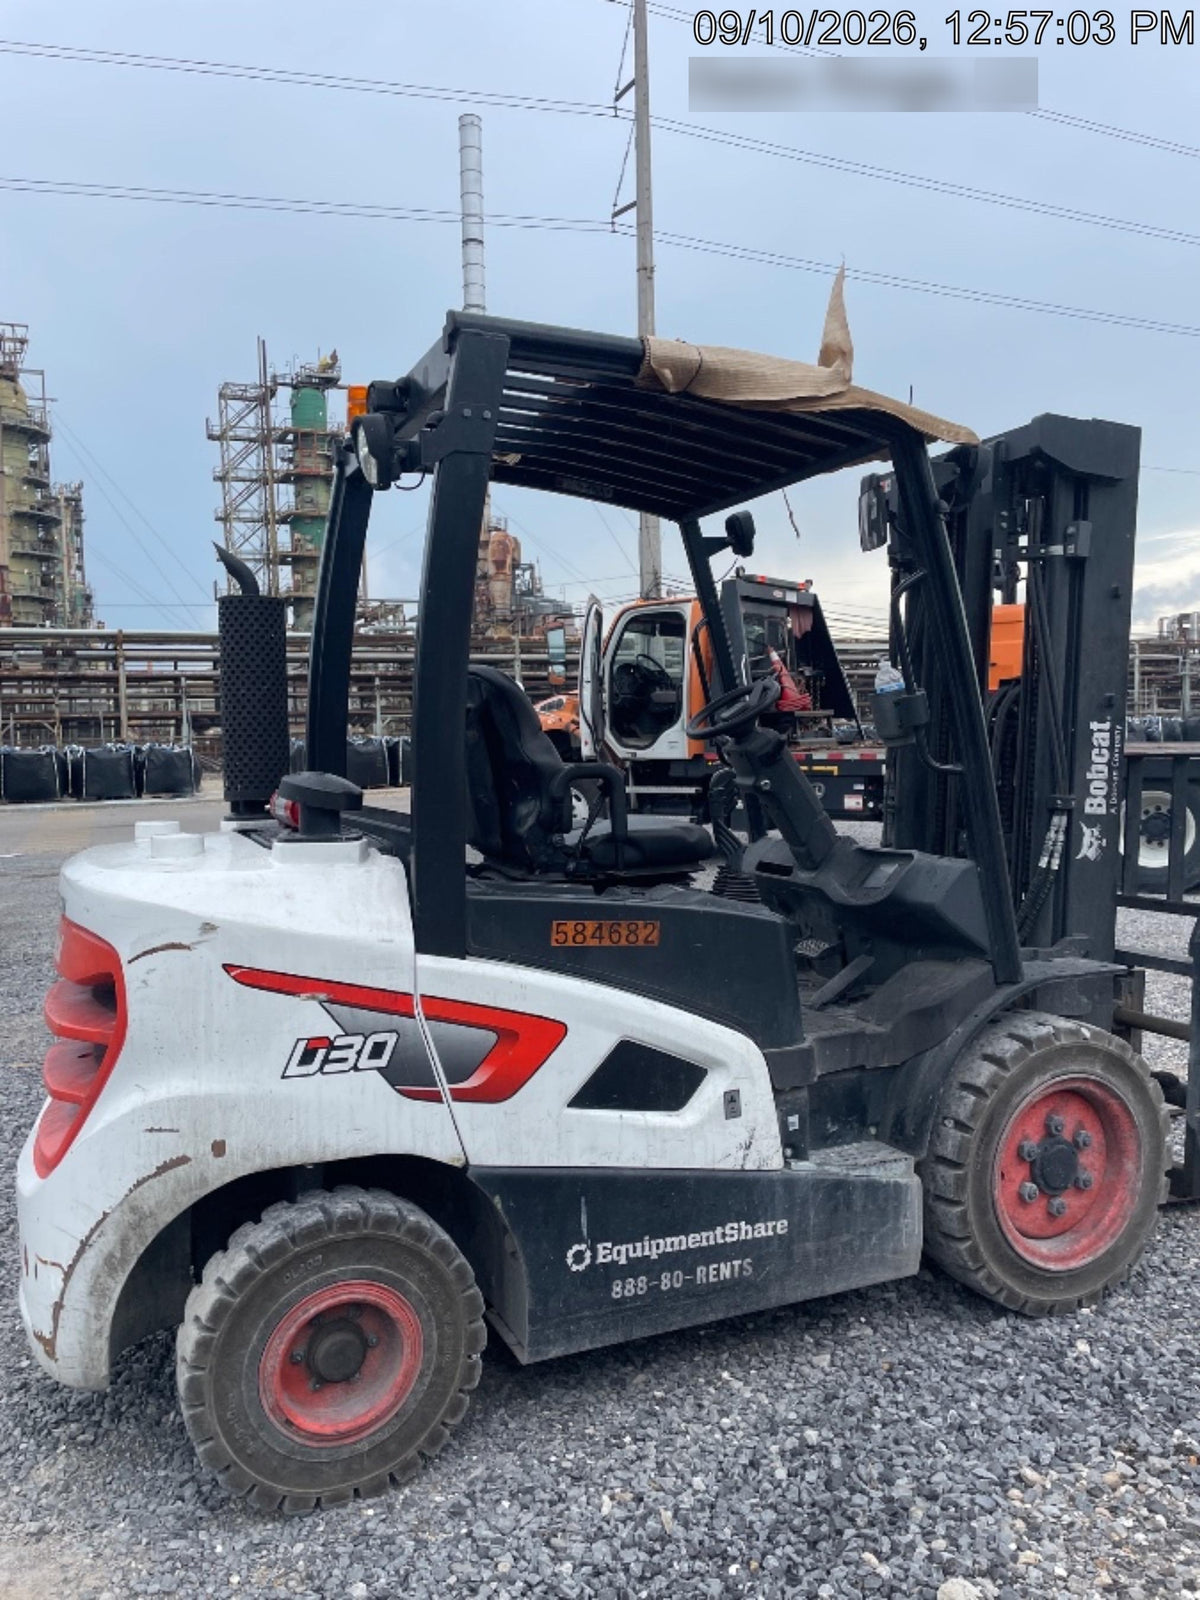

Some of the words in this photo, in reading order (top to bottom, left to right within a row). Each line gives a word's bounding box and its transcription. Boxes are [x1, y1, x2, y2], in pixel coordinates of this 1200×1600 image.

[1084, 721, 1111, 815] Bobcat
[554, 921, 657, 945] 584682
[280, 1029, 400, 1079] D30
[595, 1218, 789, 1265] EquipmentShare
[610, 1258, 754, 1299] 888-80-RENTS
